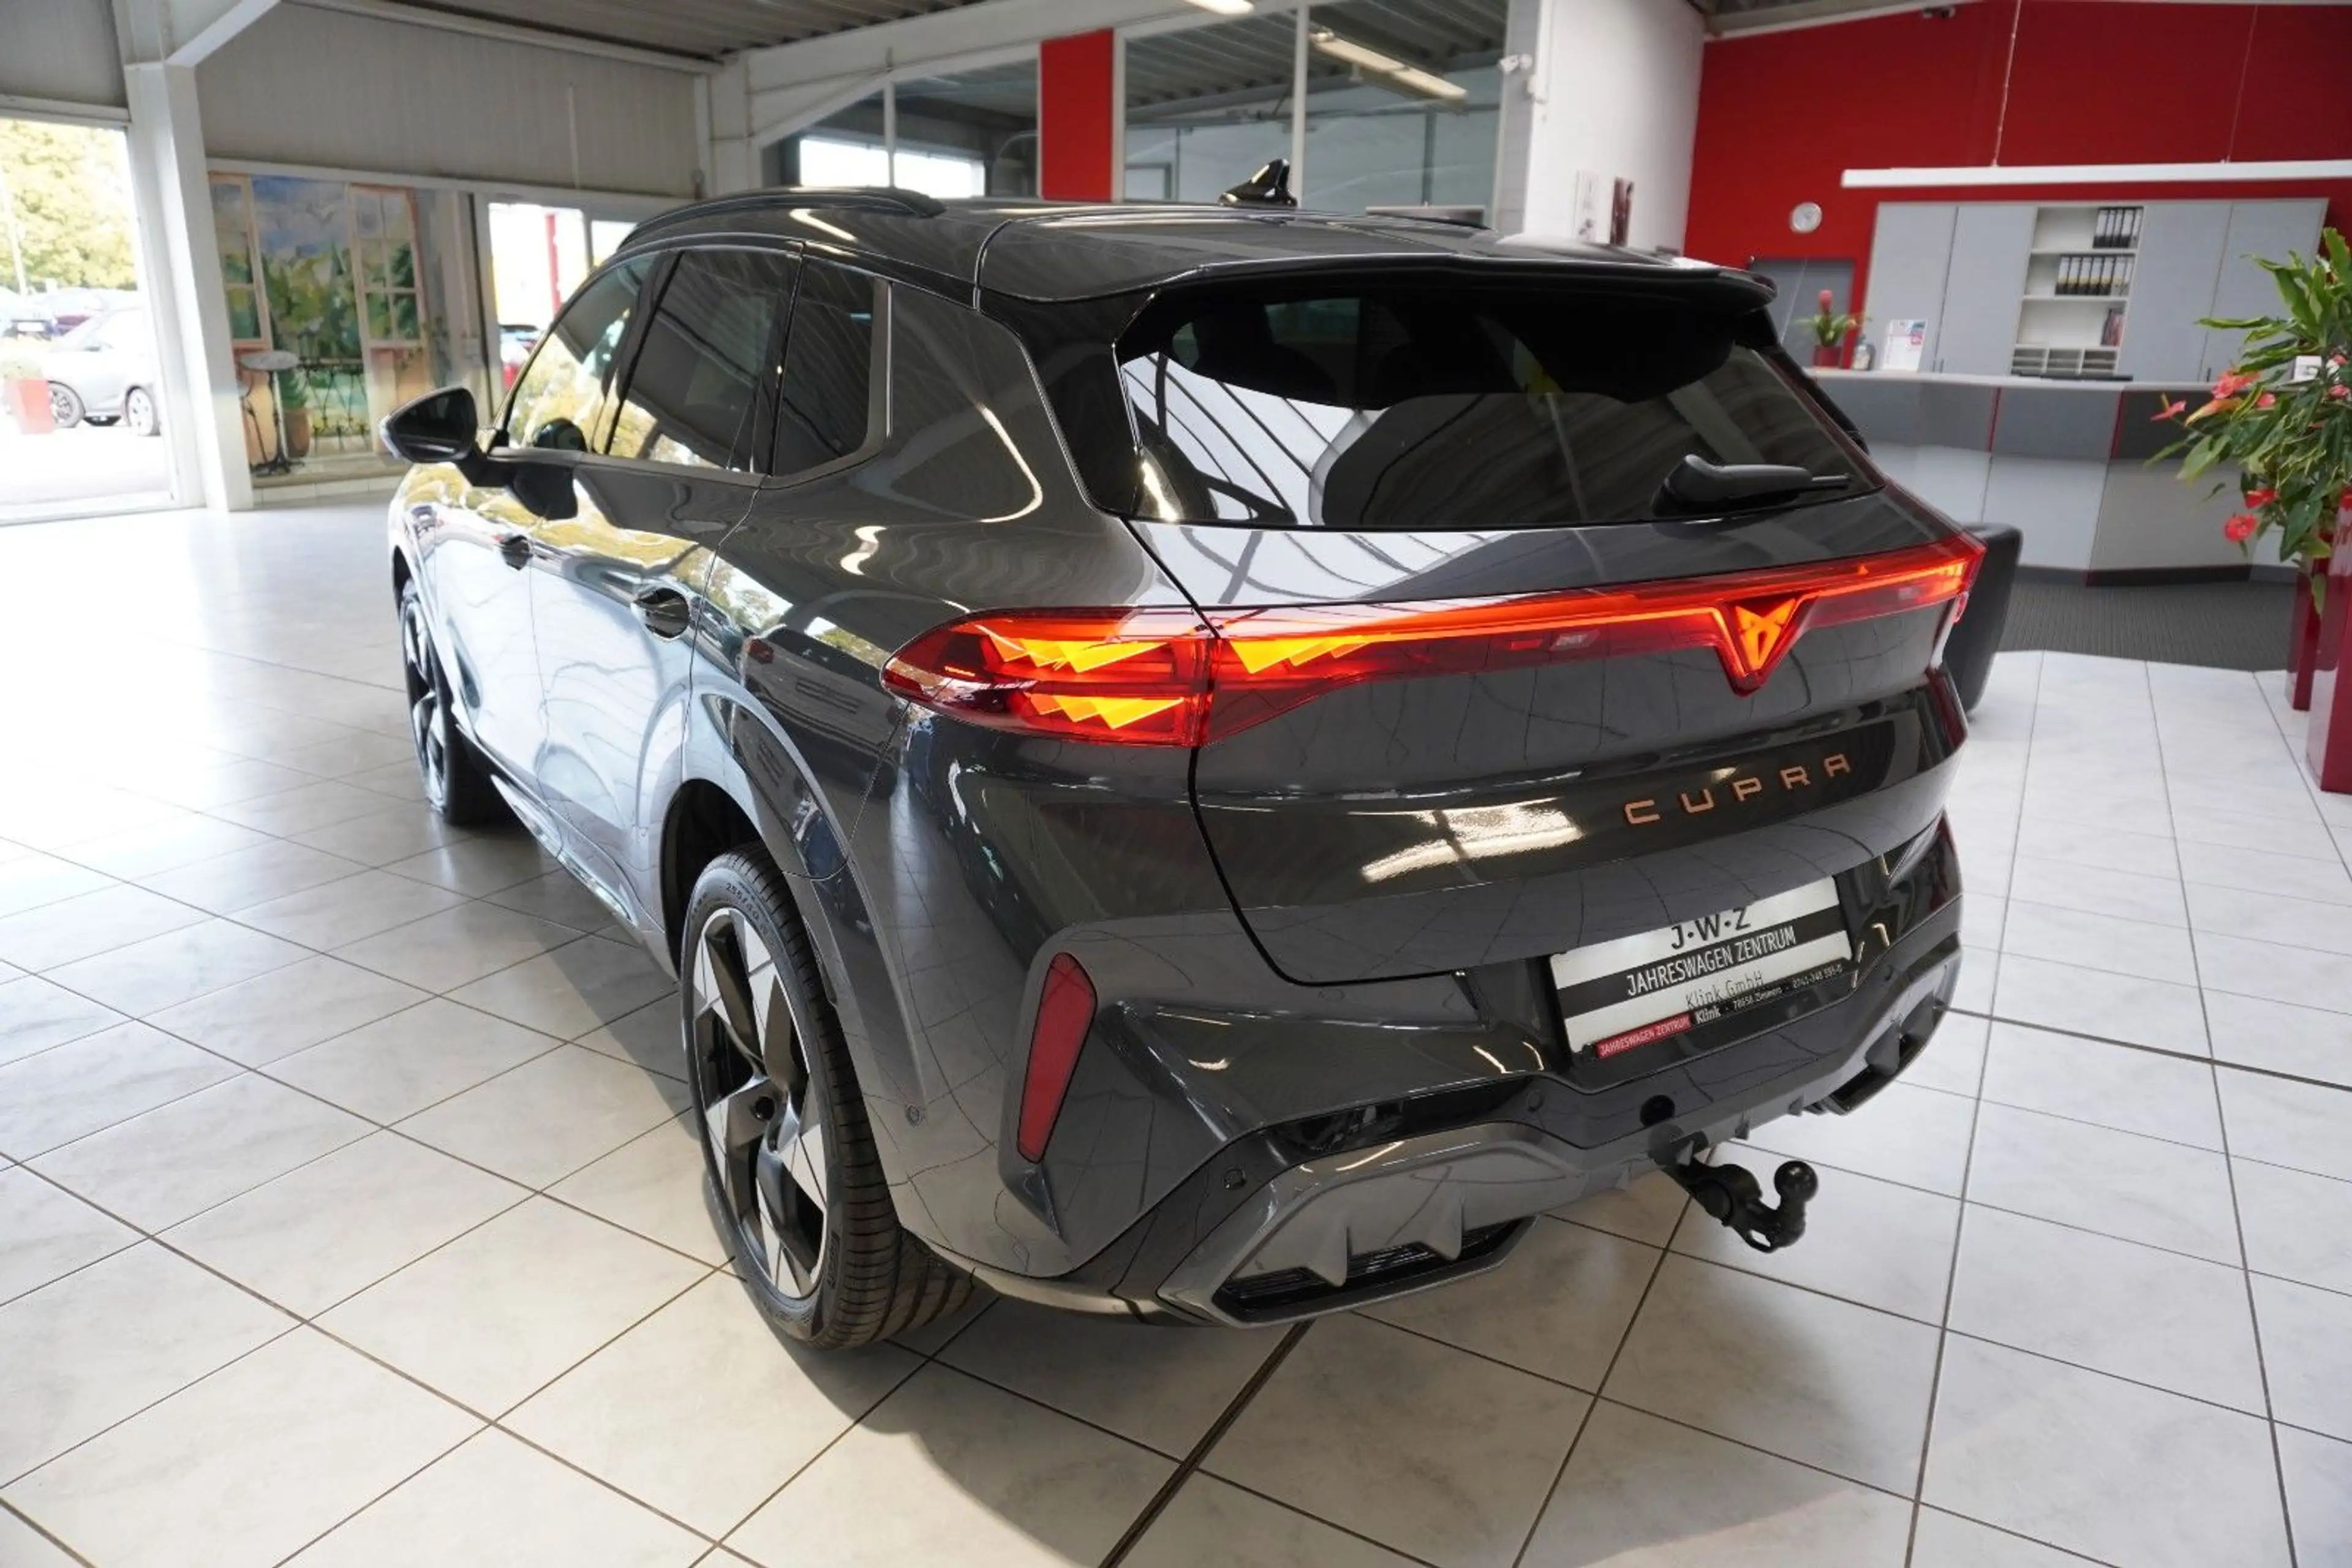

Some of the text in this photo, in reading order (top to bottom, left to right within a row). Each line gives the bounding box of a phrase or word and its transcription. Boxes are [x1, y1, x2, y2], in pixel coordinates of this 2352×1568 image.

[1624, 753, 1852, 825] CUPRA
[1626, 925, 1796, 997] JAHRESWAGEN ZENTRUM
[1686, 987, 1722, 1009] Klink
[1725, 970, 1764, 997] GmbH
[1599, 1029, 1655, 1057] JAHRESWAGEN
[1655, 1016, 1691, 1036] ZENTRUM
[1695, 1006, 1722, 1024] Klink
